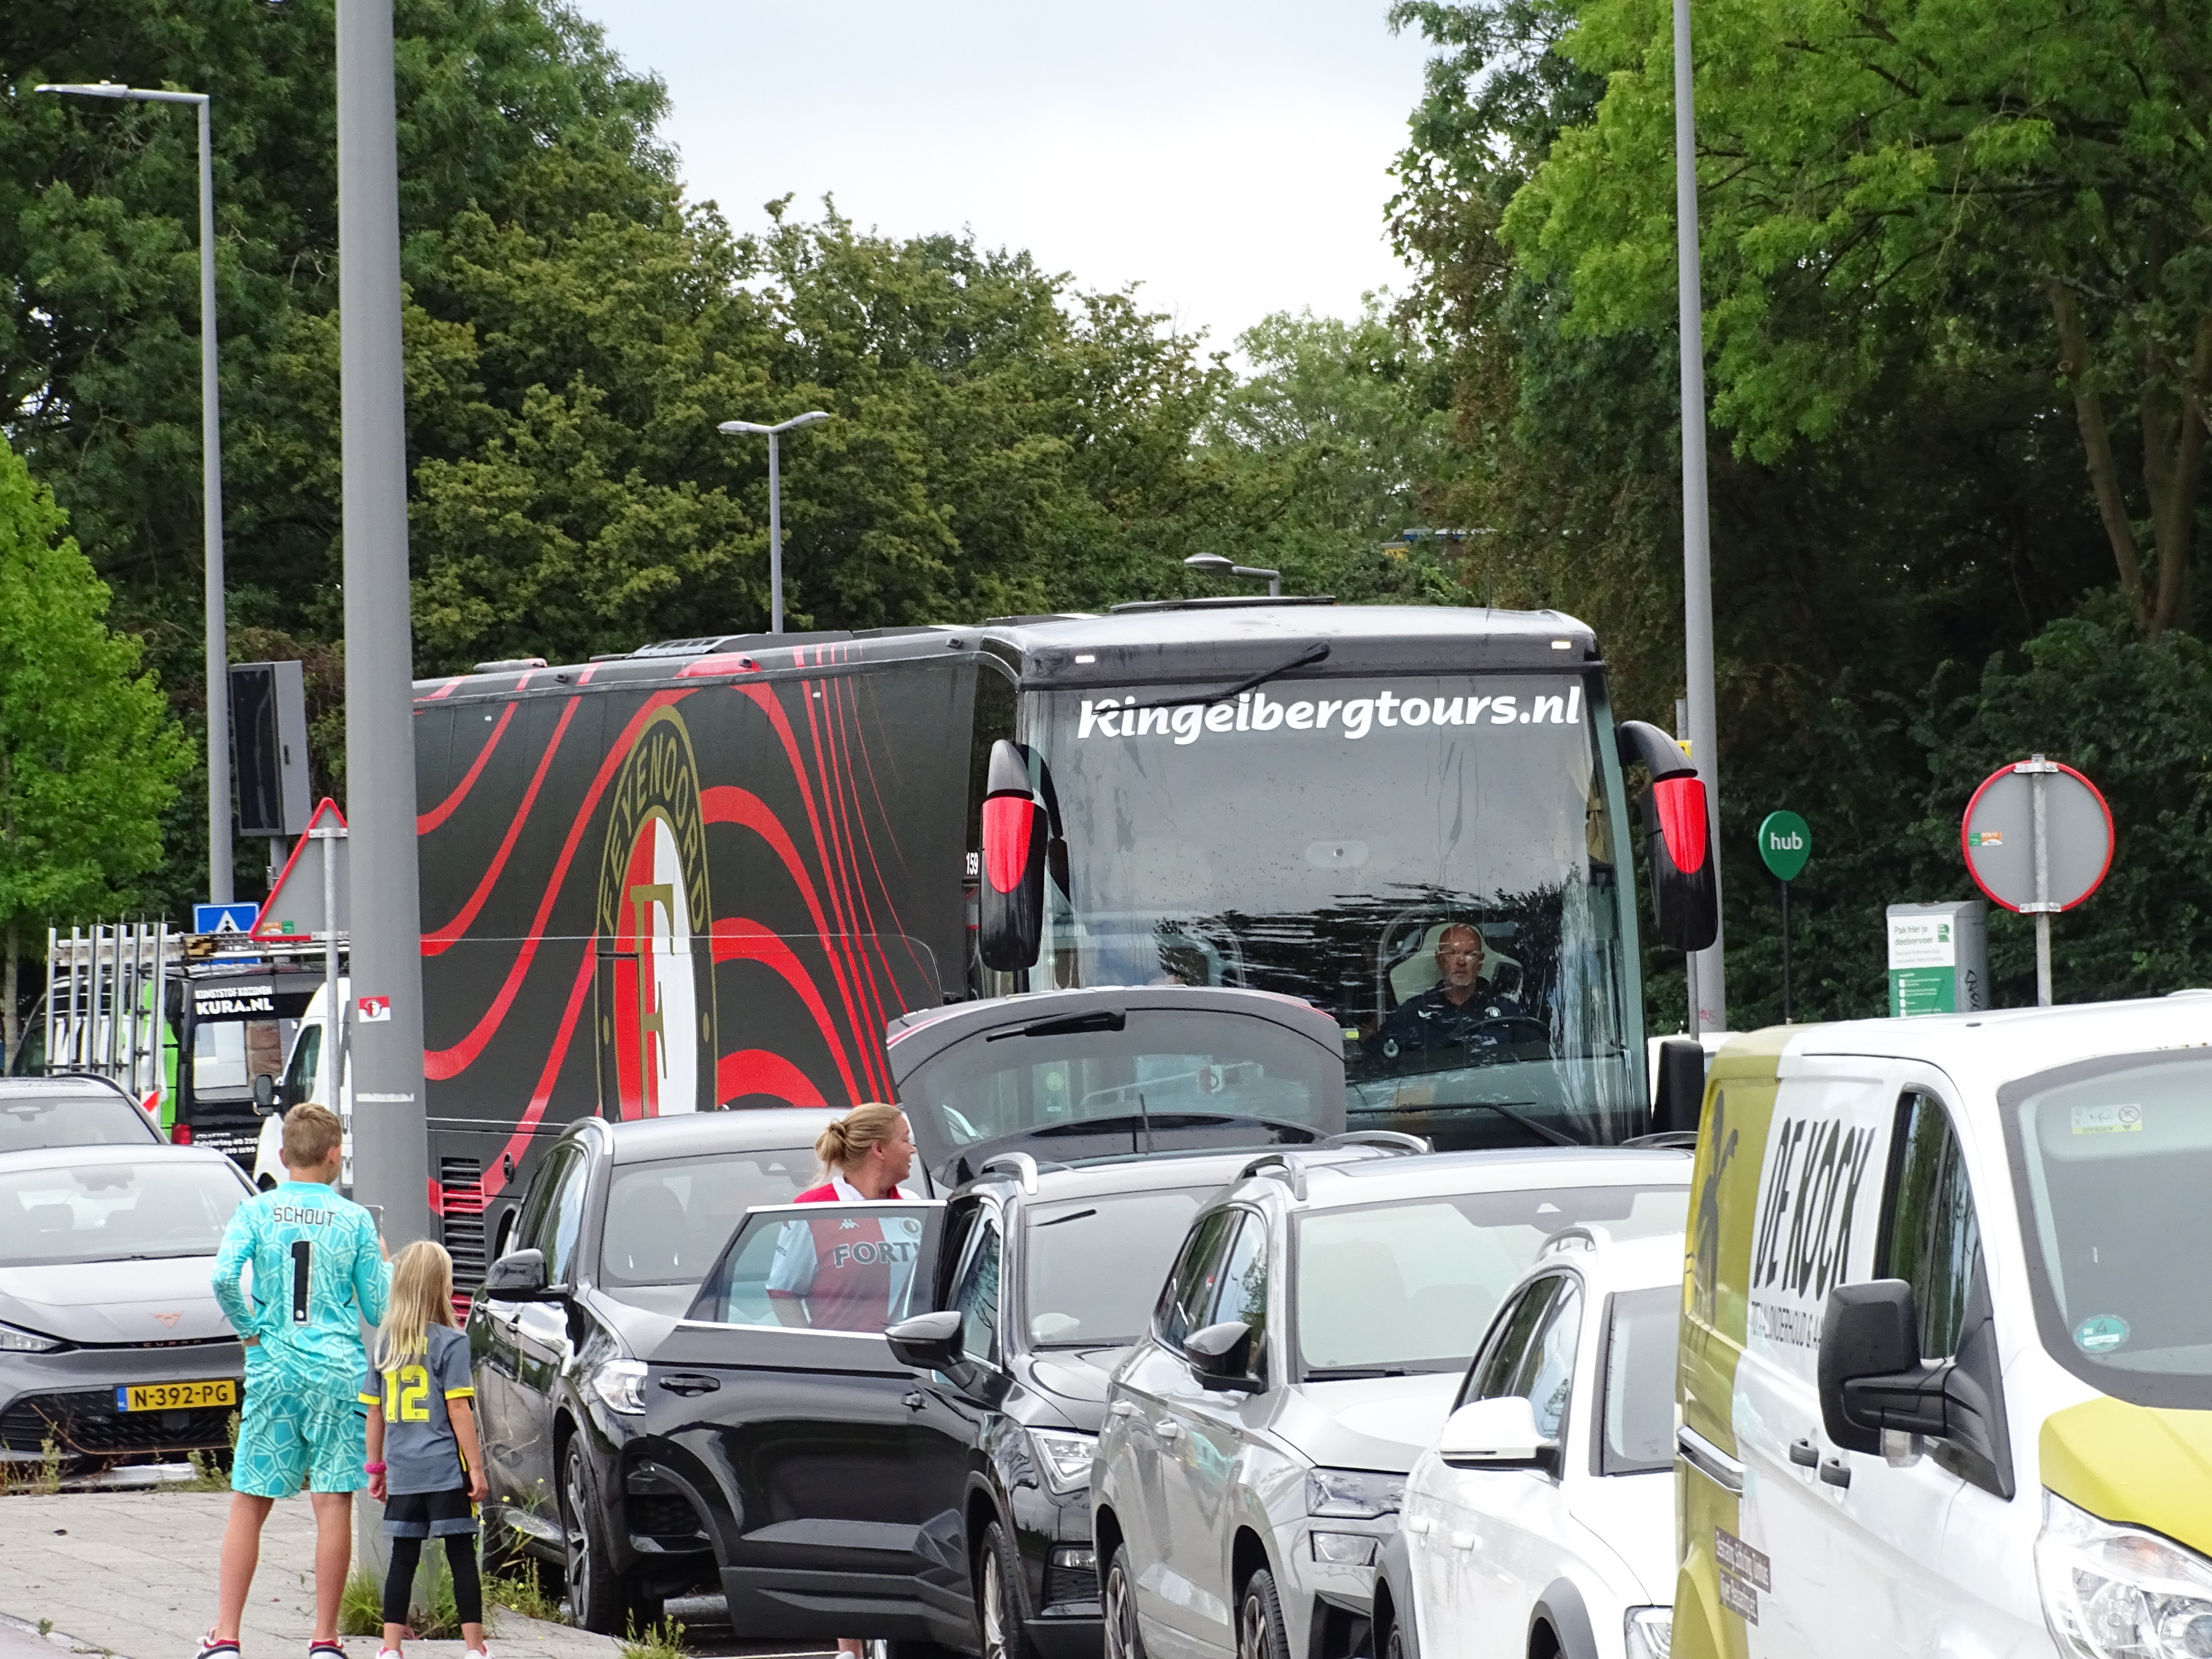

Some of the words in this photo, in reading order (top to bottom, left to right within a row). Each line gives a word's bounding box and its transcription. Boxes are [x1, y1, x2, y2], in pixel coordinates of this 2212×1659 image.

[601, 733, 706, 935] FEYENOORD
[1770, 831, 1803, 850] hub
[966, 852, 978, 875] 159
[1894, 926, 1907, 934] Pak
[1907, 925, 1920, 933] hier
[195, 987, 237, 999] KUNSTSTOF
[196, 997, 274, 1015] KURA.NL
[274, 1206, 336, 1227] SCHOUT
[1753, 1116, 1806, 1289] DE
[1782, 1118, 1876, 1302] KOCK
[291, 1240, 315, 1327] 1
[134, 1384, 228, 1407] N-392-PG
[384, 1364, 430, 1423] 12
